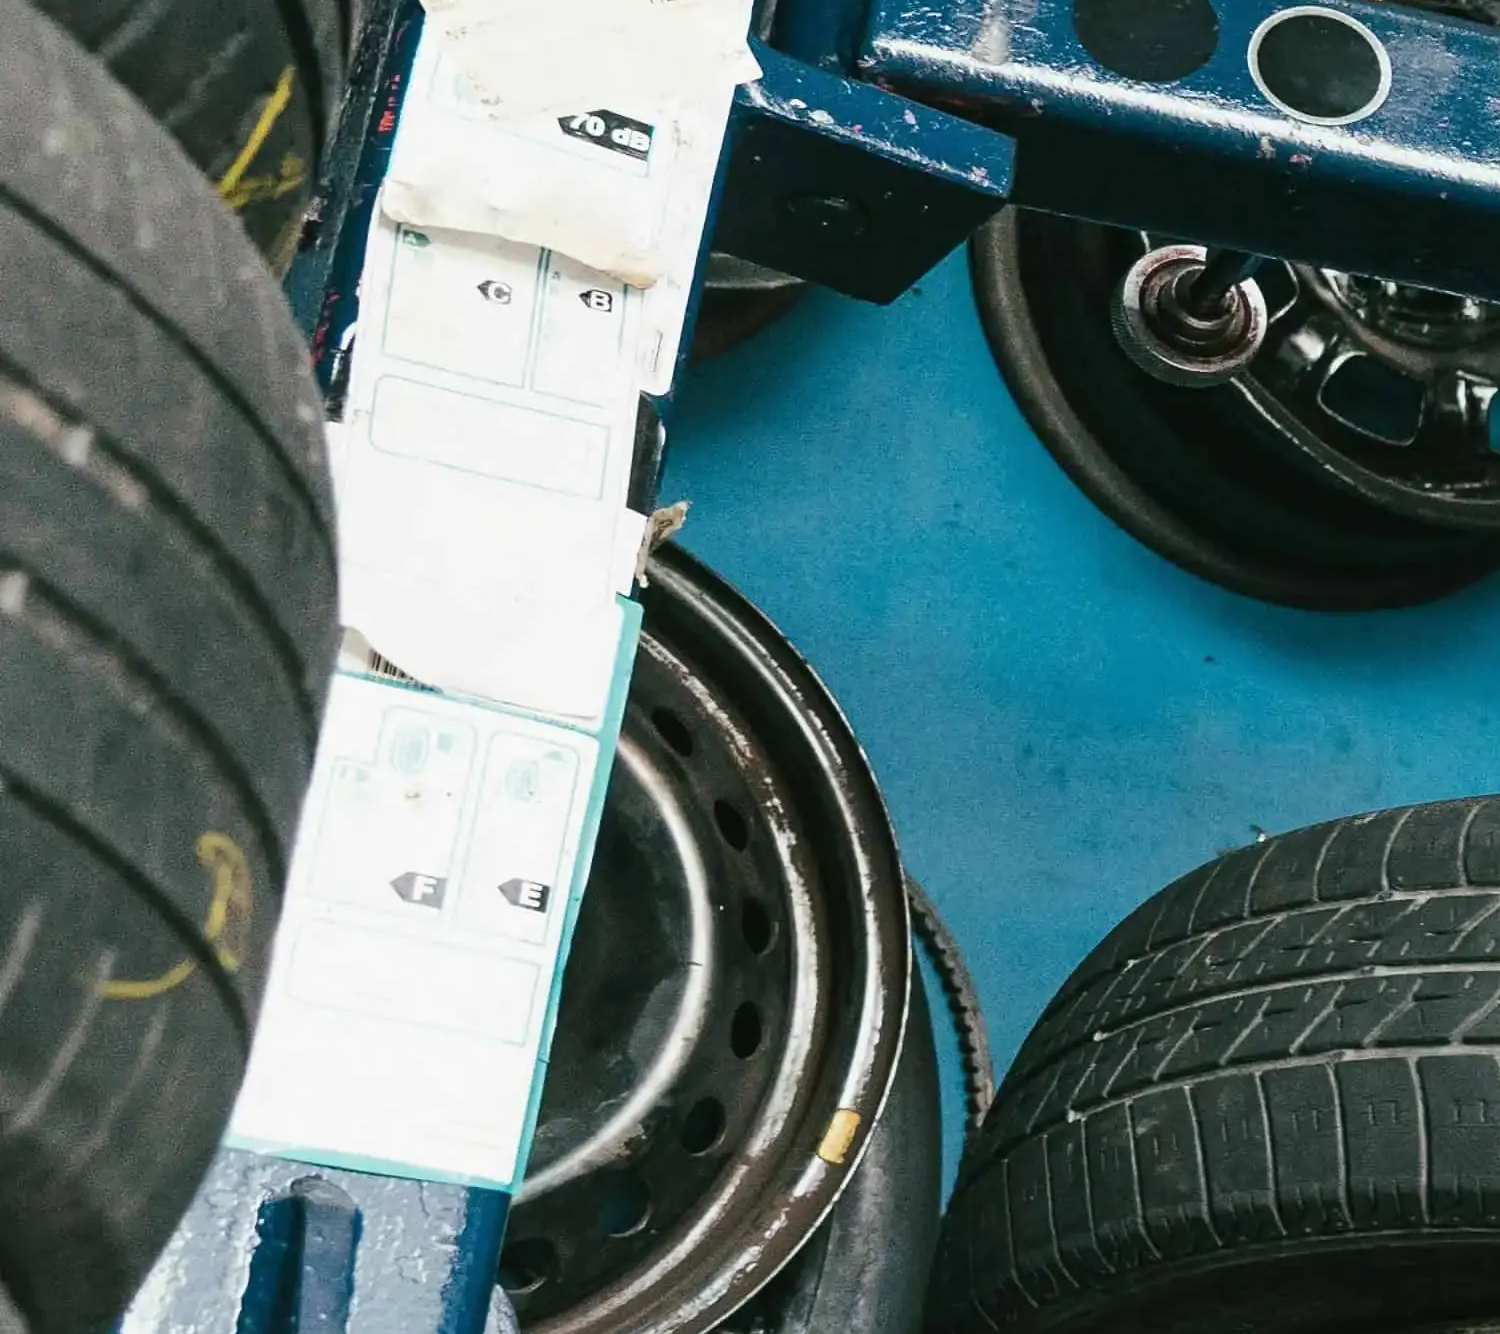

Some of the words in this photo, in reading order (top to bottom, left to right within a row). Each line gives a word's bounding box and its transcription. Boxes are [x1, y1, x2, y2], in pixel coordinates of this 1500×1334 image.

[570, 113, 606, 137] 70
[611, 127, 650, 151] dB
[588, 290, 614, 312] B
[413, 876, 438, 902] F
[525, 884, 546, 909] E
